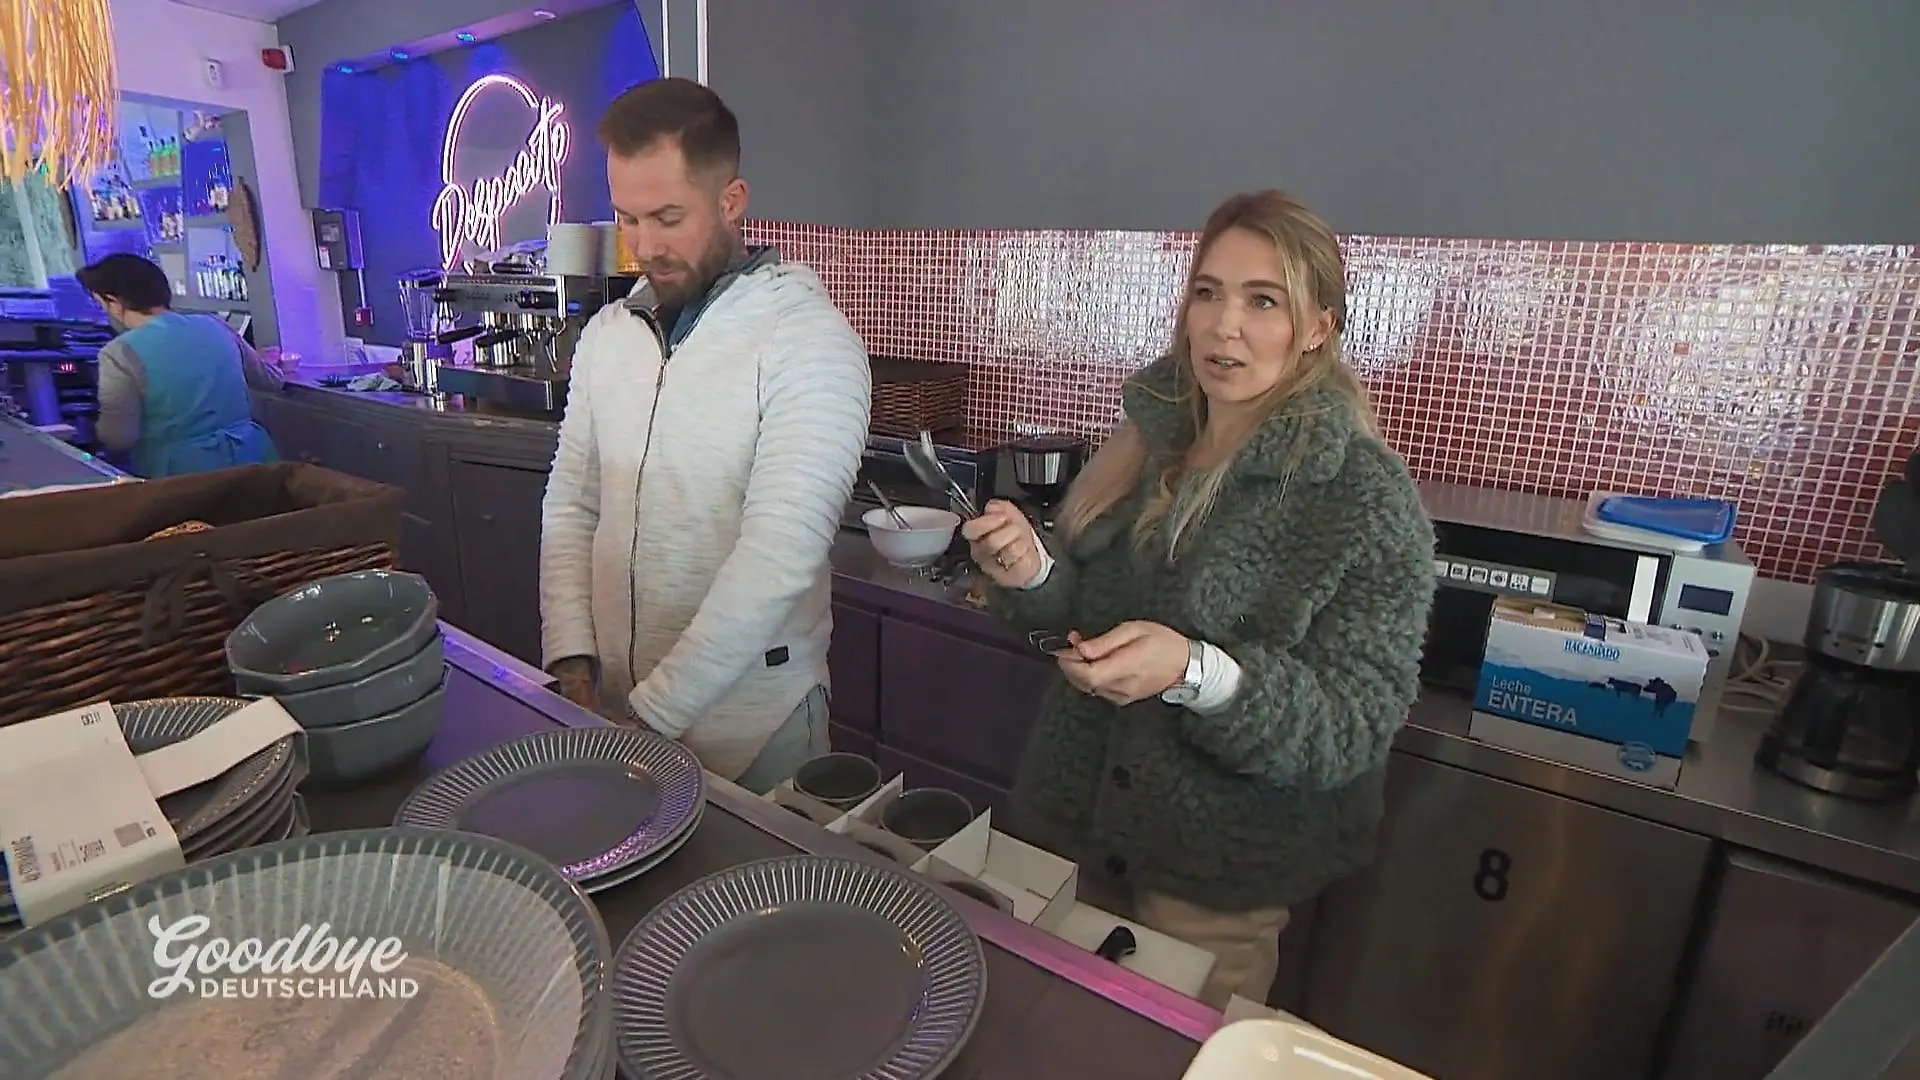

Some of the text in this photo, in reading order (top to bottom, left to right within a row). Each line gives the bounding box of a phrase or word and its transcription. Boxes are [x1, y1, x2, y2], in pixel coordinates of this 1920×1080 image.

[1492, 674, 1532, 695] Leche
[1487, 688, 1578, 727] ENTERA
[1474, 848, 1512, 901] 8
